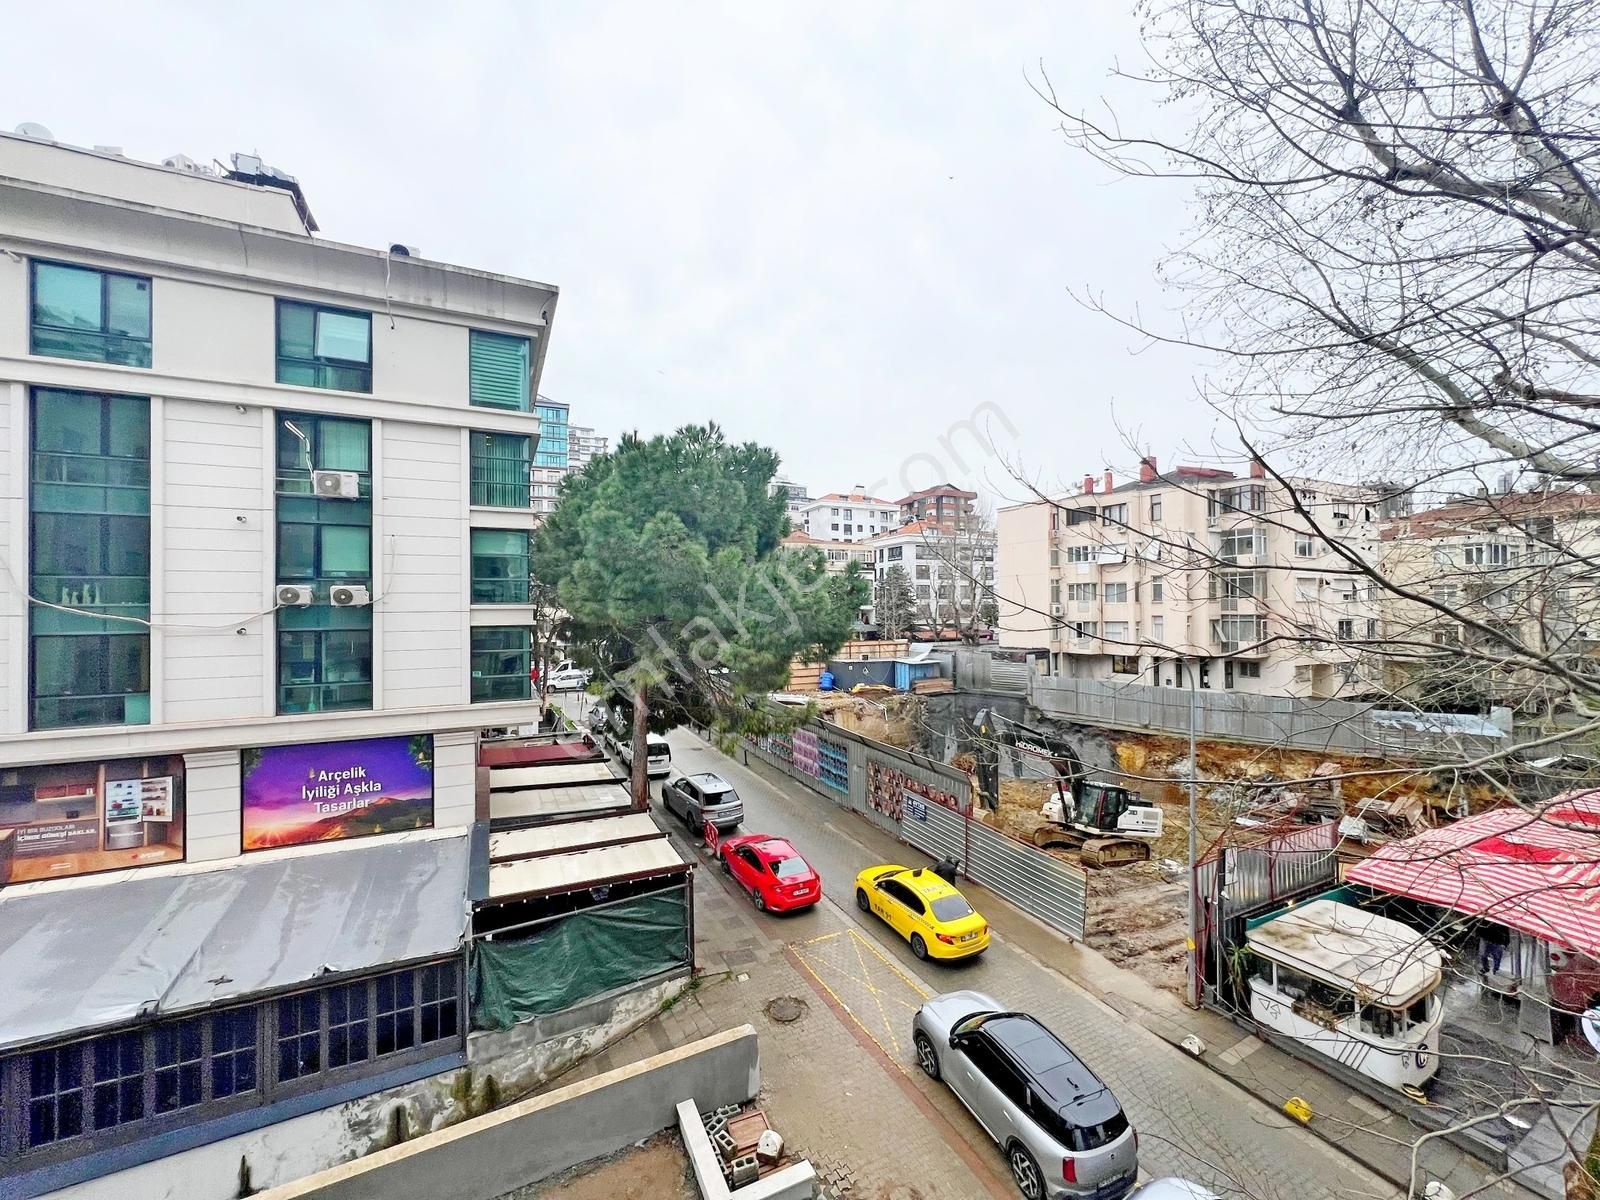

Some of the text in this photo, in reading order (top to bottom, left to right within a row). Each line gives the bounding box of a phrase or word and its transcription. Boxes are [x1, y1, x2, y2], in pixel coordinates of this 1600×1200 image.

[318, 766, 367, 782] Arçelik
[302, 780, 382, 801] İyiliği Aşkla
[314, 797, 371, 813] Tasarlar
